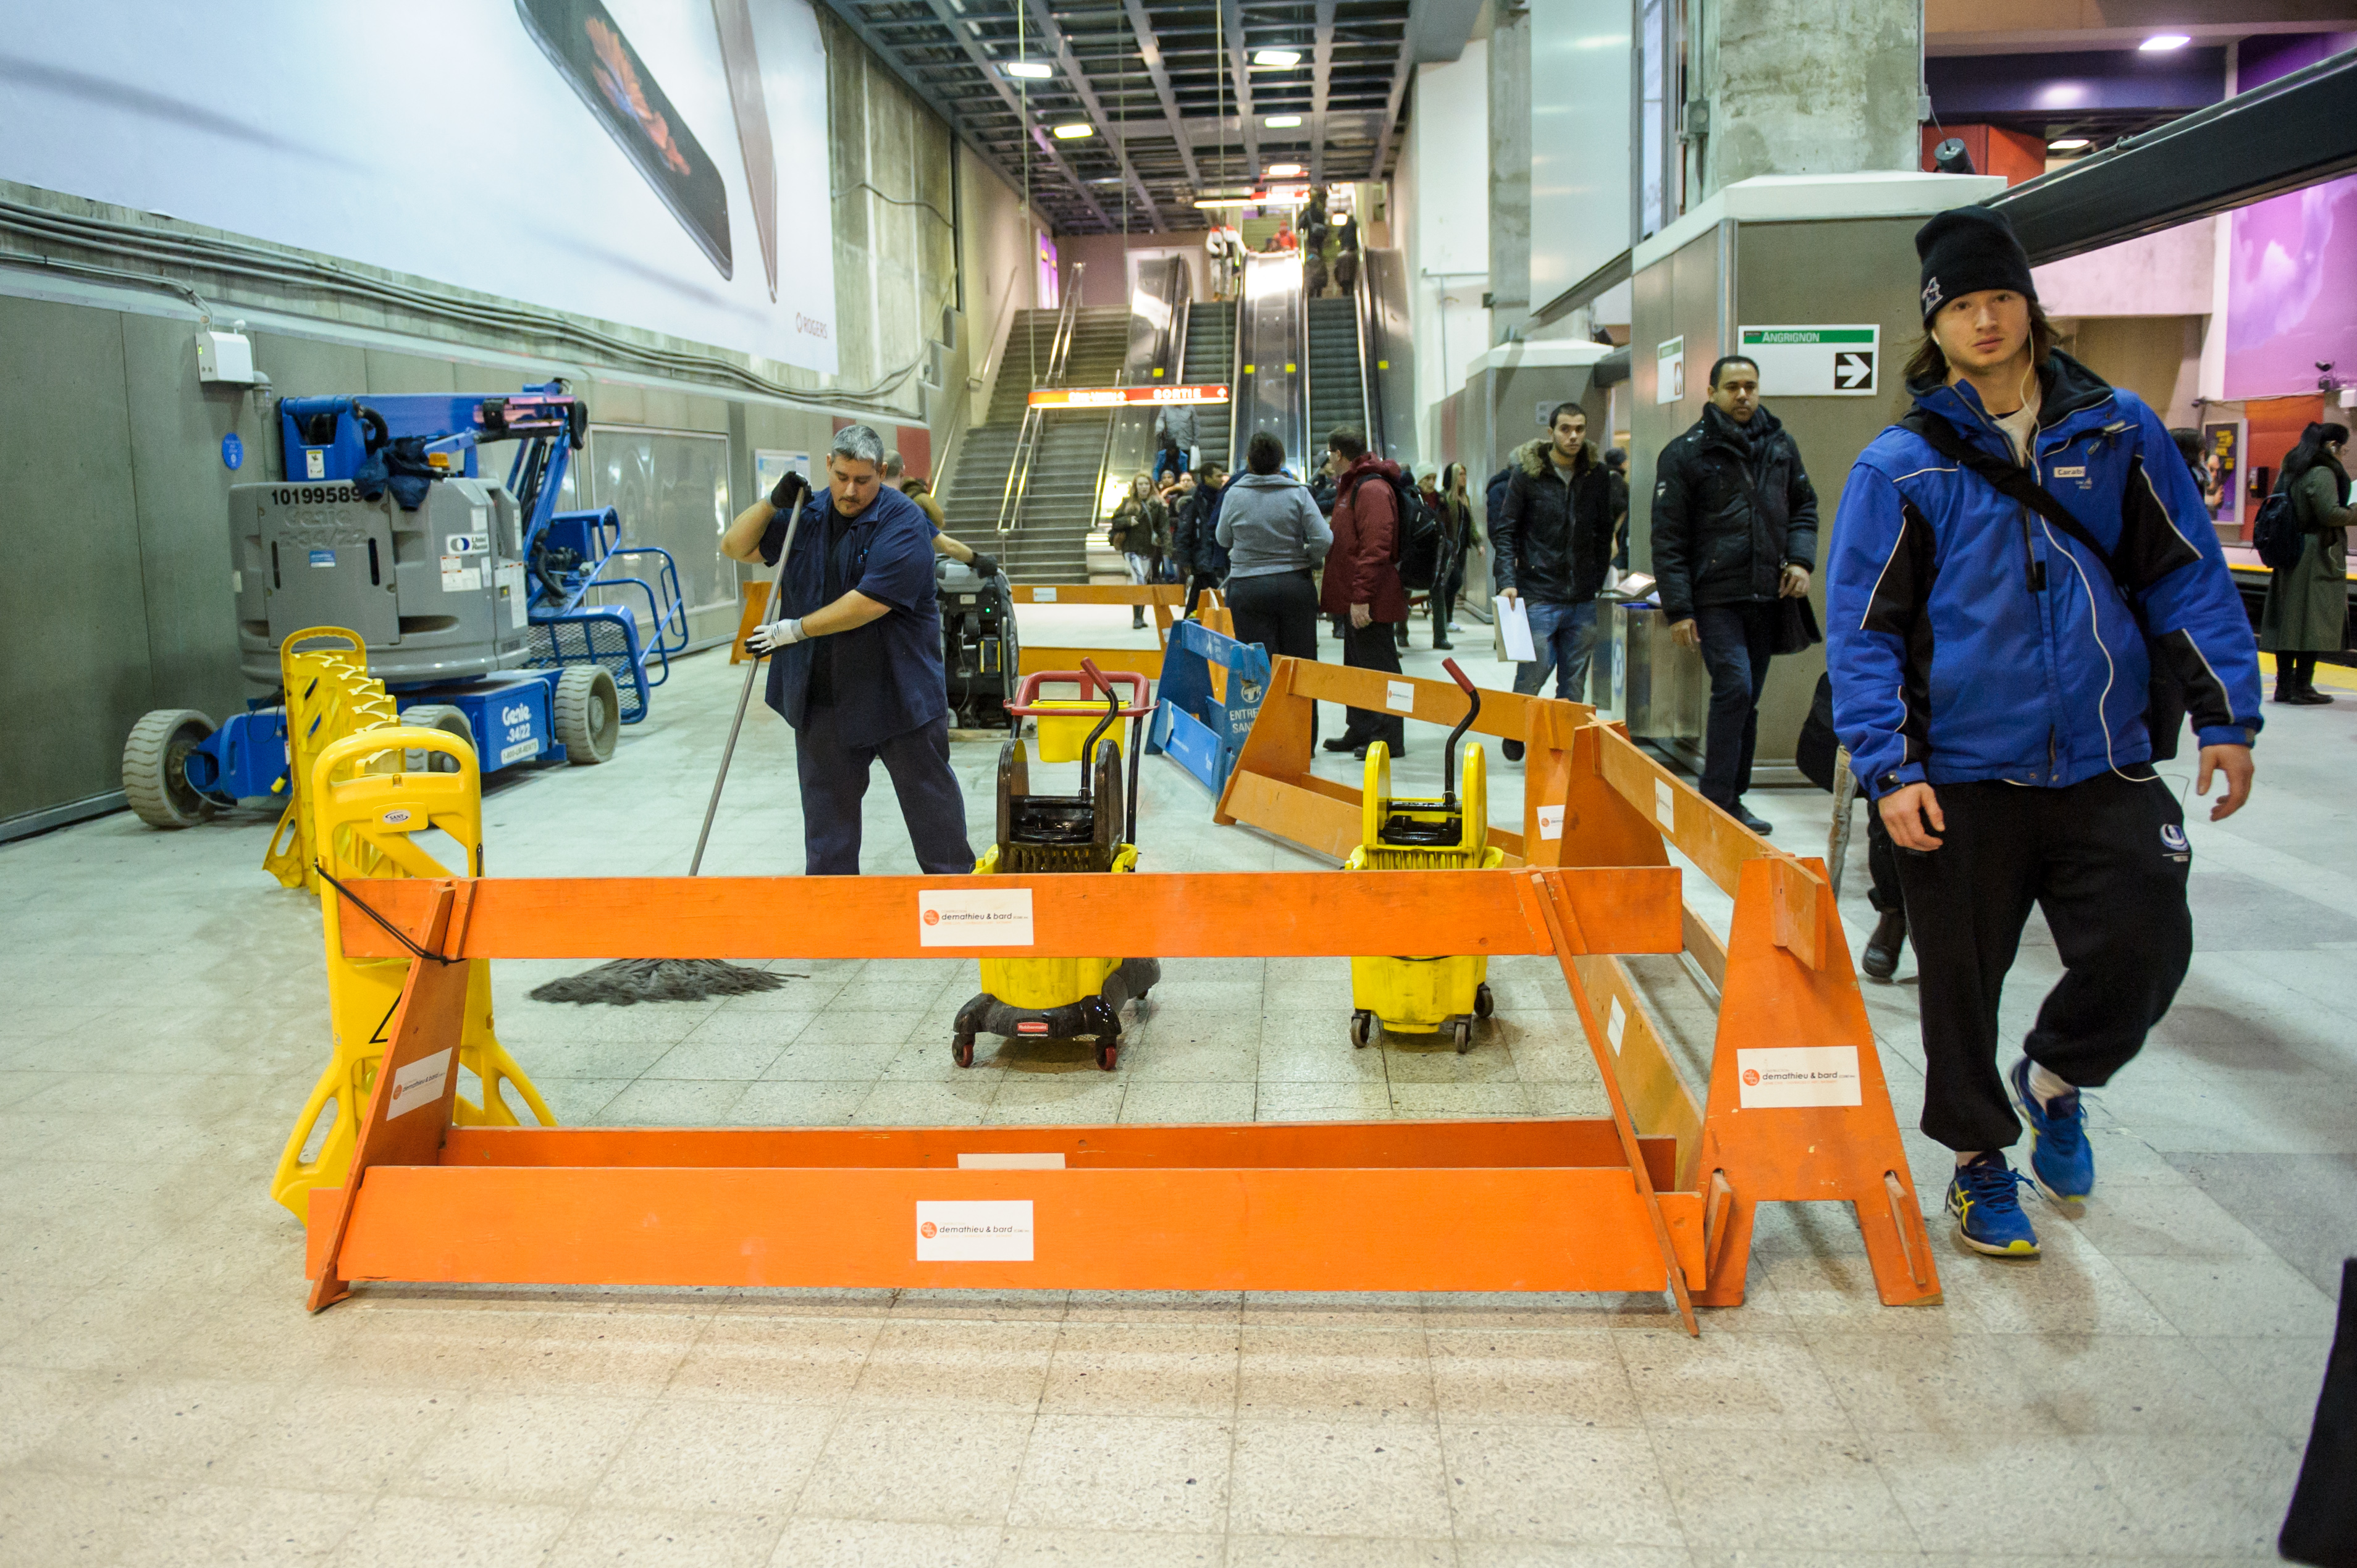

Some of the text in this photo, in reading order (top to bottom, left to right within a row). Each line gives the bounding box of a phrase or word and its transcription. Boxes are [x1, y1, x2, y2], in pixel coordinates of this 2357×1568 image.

[804, 316, 828, 339] ROGERS
[1762, 332, 1820, 342] ANGRIGNON
[1153, 388, 1201, 399] SORTIE
[272, 487, 363, 505] 10199589
[502, 703, 530, 727] Genie
[403, 1079, 425, 1092] demathieu
[429, 1072, 439, 1081] bard
[1762, 1072, 1809, 1080] demathieu
